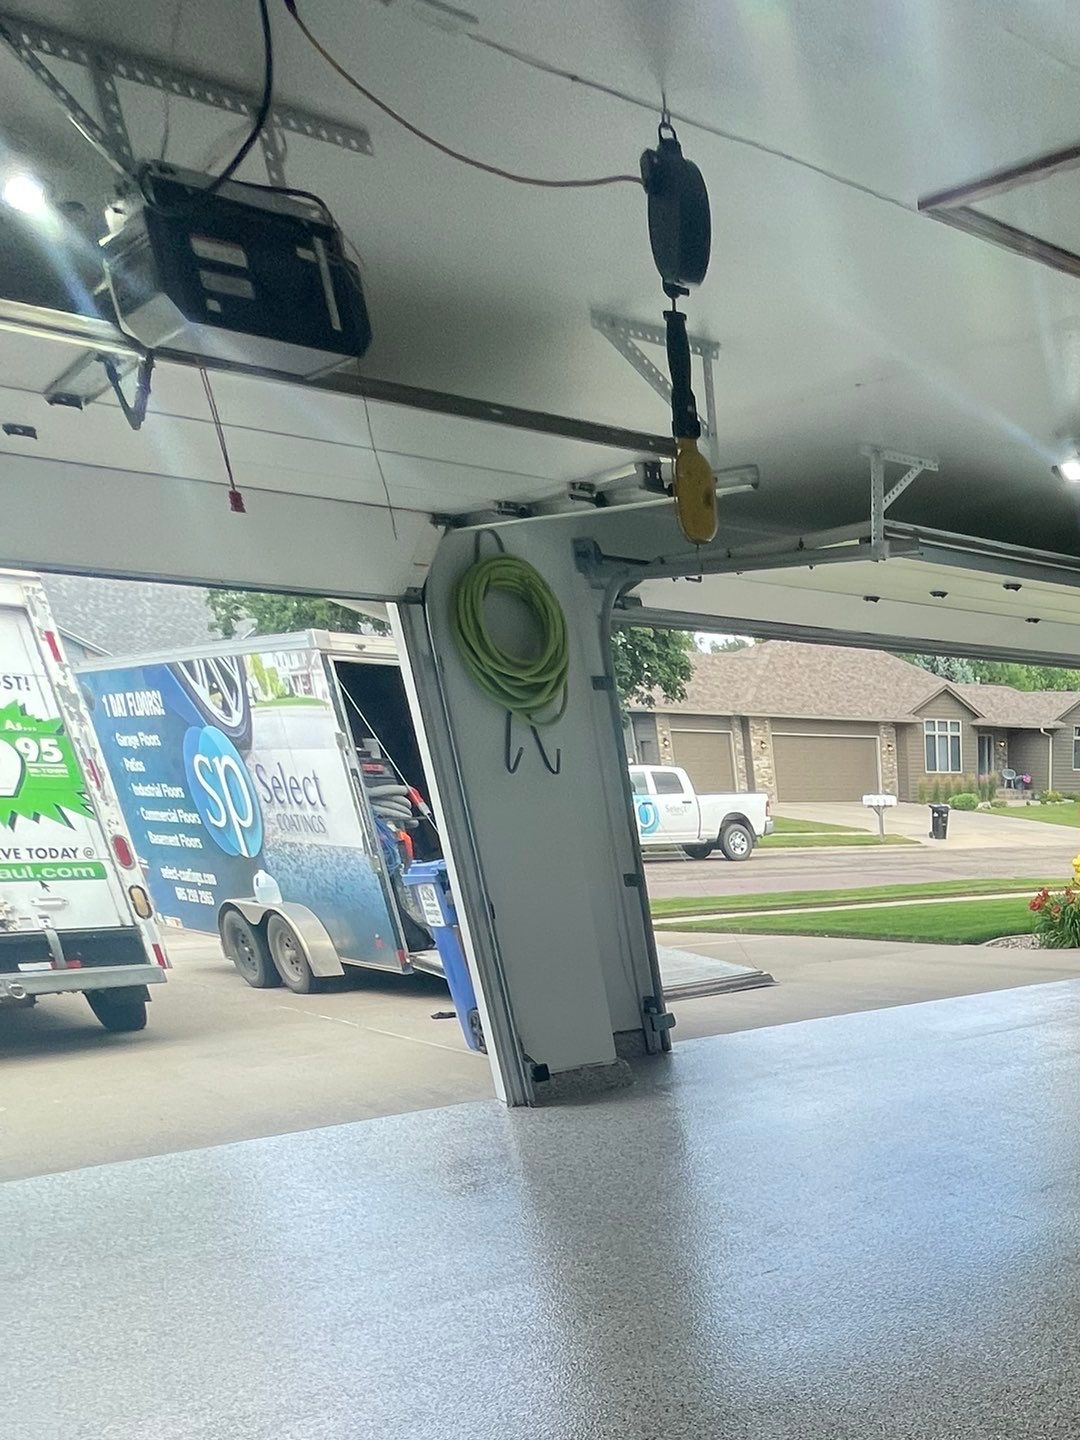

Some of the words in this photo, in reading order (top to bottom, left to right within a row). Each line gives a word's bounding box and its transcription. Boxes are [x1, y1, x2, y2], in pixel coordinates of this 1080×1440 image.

[0, 675, 31, 691] ST!
[101, 694, 111, 717] 1
[109, 693, 128, 717] DAY
[126, 690, 165, 717] FLOORS!
[137, 731, 162, 747] Floors
[161, 783, 185, 798] Floors
[255, 762, 327, 807] Select
[177, 809, 202, 825] Floors
[276, 813, 328, 834] COATINGS
[179, 834, 203, 849] Floors
[0, 847, 21, 860] VE
[25, 847, 79, 860] TODAY
[83, 847, 95, 859] @
